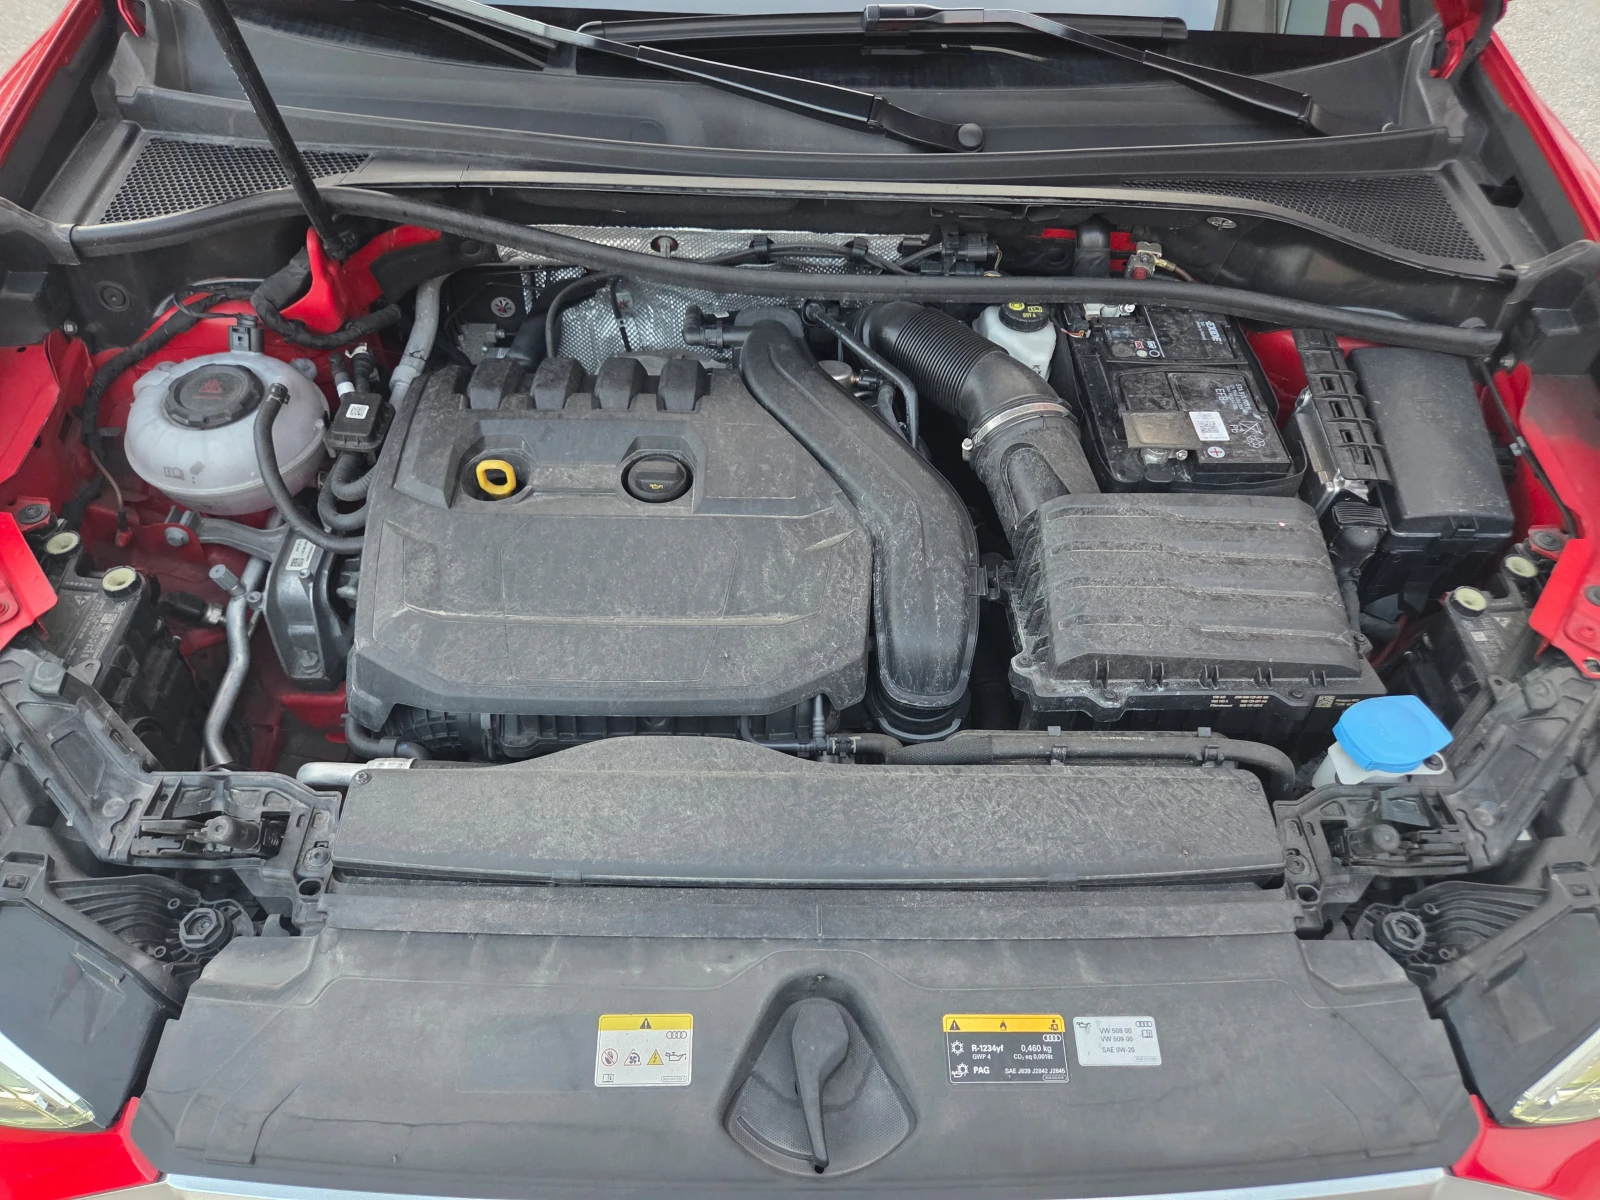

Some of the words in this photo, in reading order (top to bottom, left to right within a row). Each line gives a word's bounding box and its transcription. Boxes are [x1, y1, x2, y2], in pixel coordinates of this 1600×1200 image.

[1229, 424, 1240, 434] Pb
[971, 1044, 1004, 1053] R-1234yf
[1020, 1044, 1042, 1052] 0,460
[1042, 1044, 1053, 1053] kg
[973, 1066, 990, 1074] PAG
